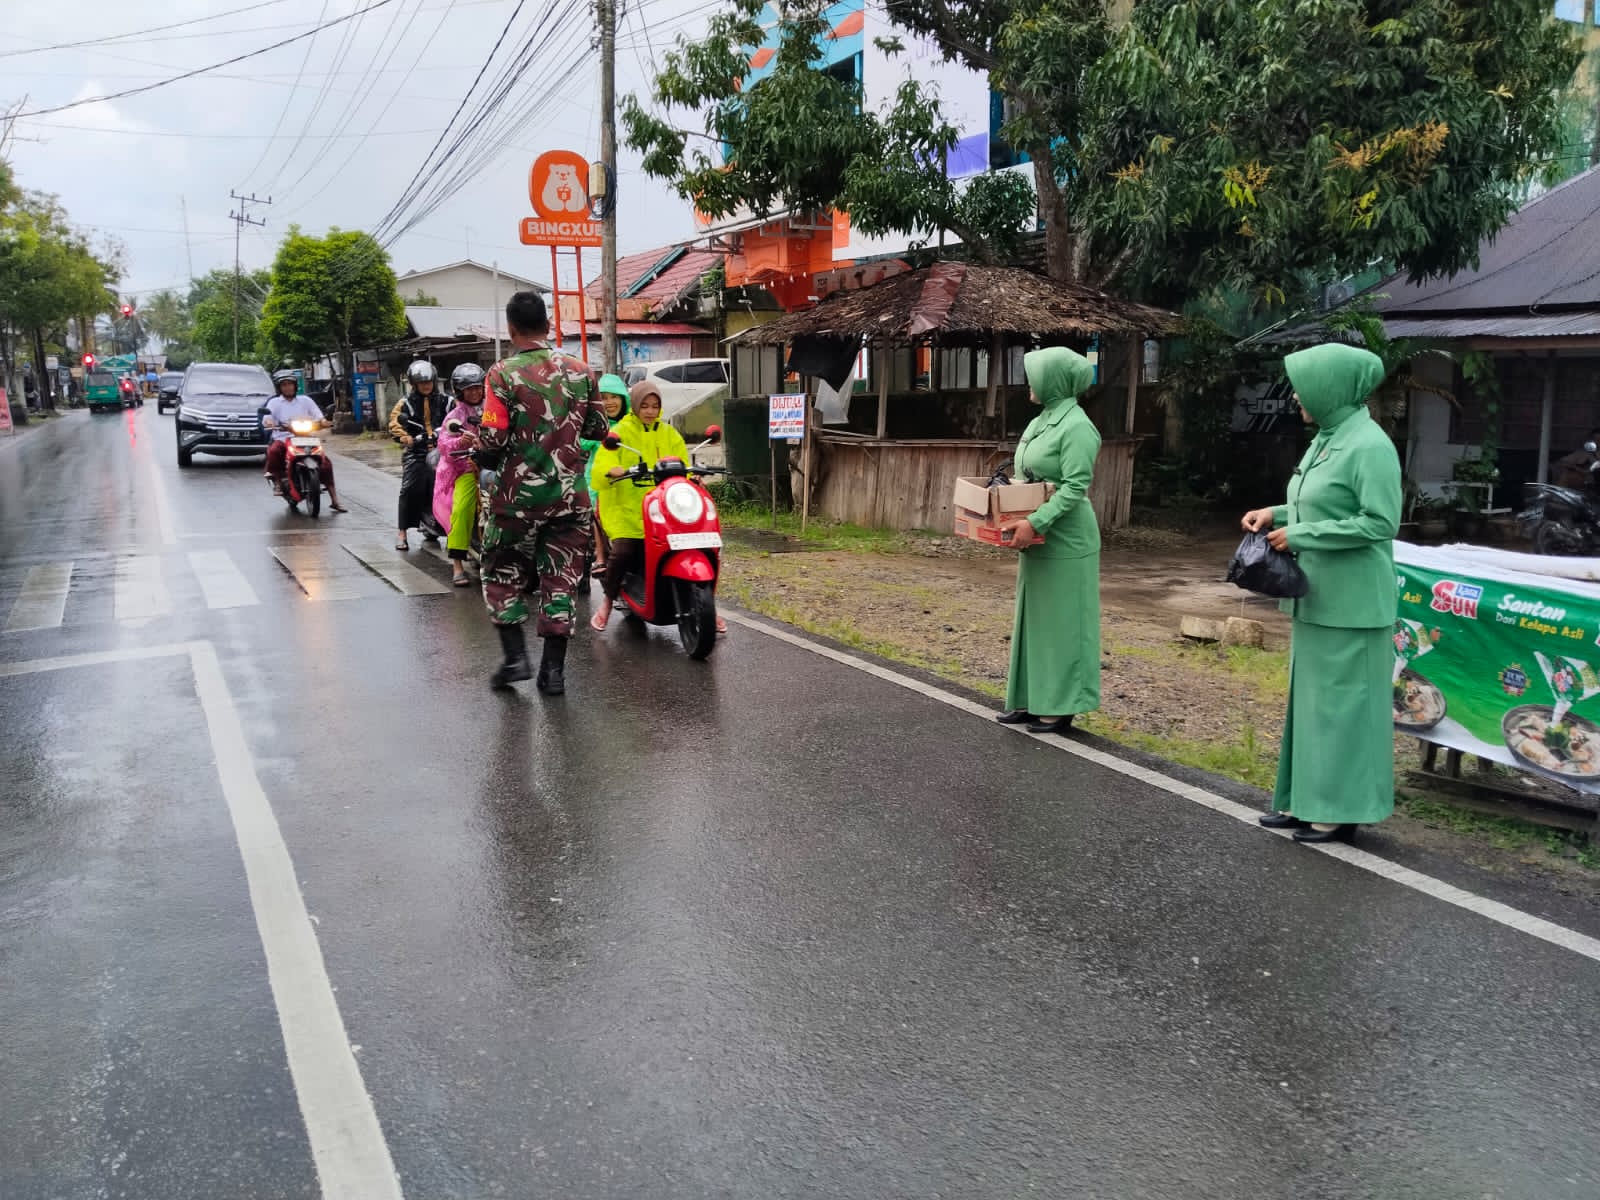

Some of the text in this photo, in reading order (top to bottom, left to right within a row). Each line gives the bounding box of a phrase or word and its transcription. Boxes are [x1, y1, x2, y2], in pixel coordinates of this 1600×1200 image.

[1432, 581, 1477, 618] SUN
[1497, 594, 1567, 622] Santan
[1496, 612, 1517, 625] Dari
